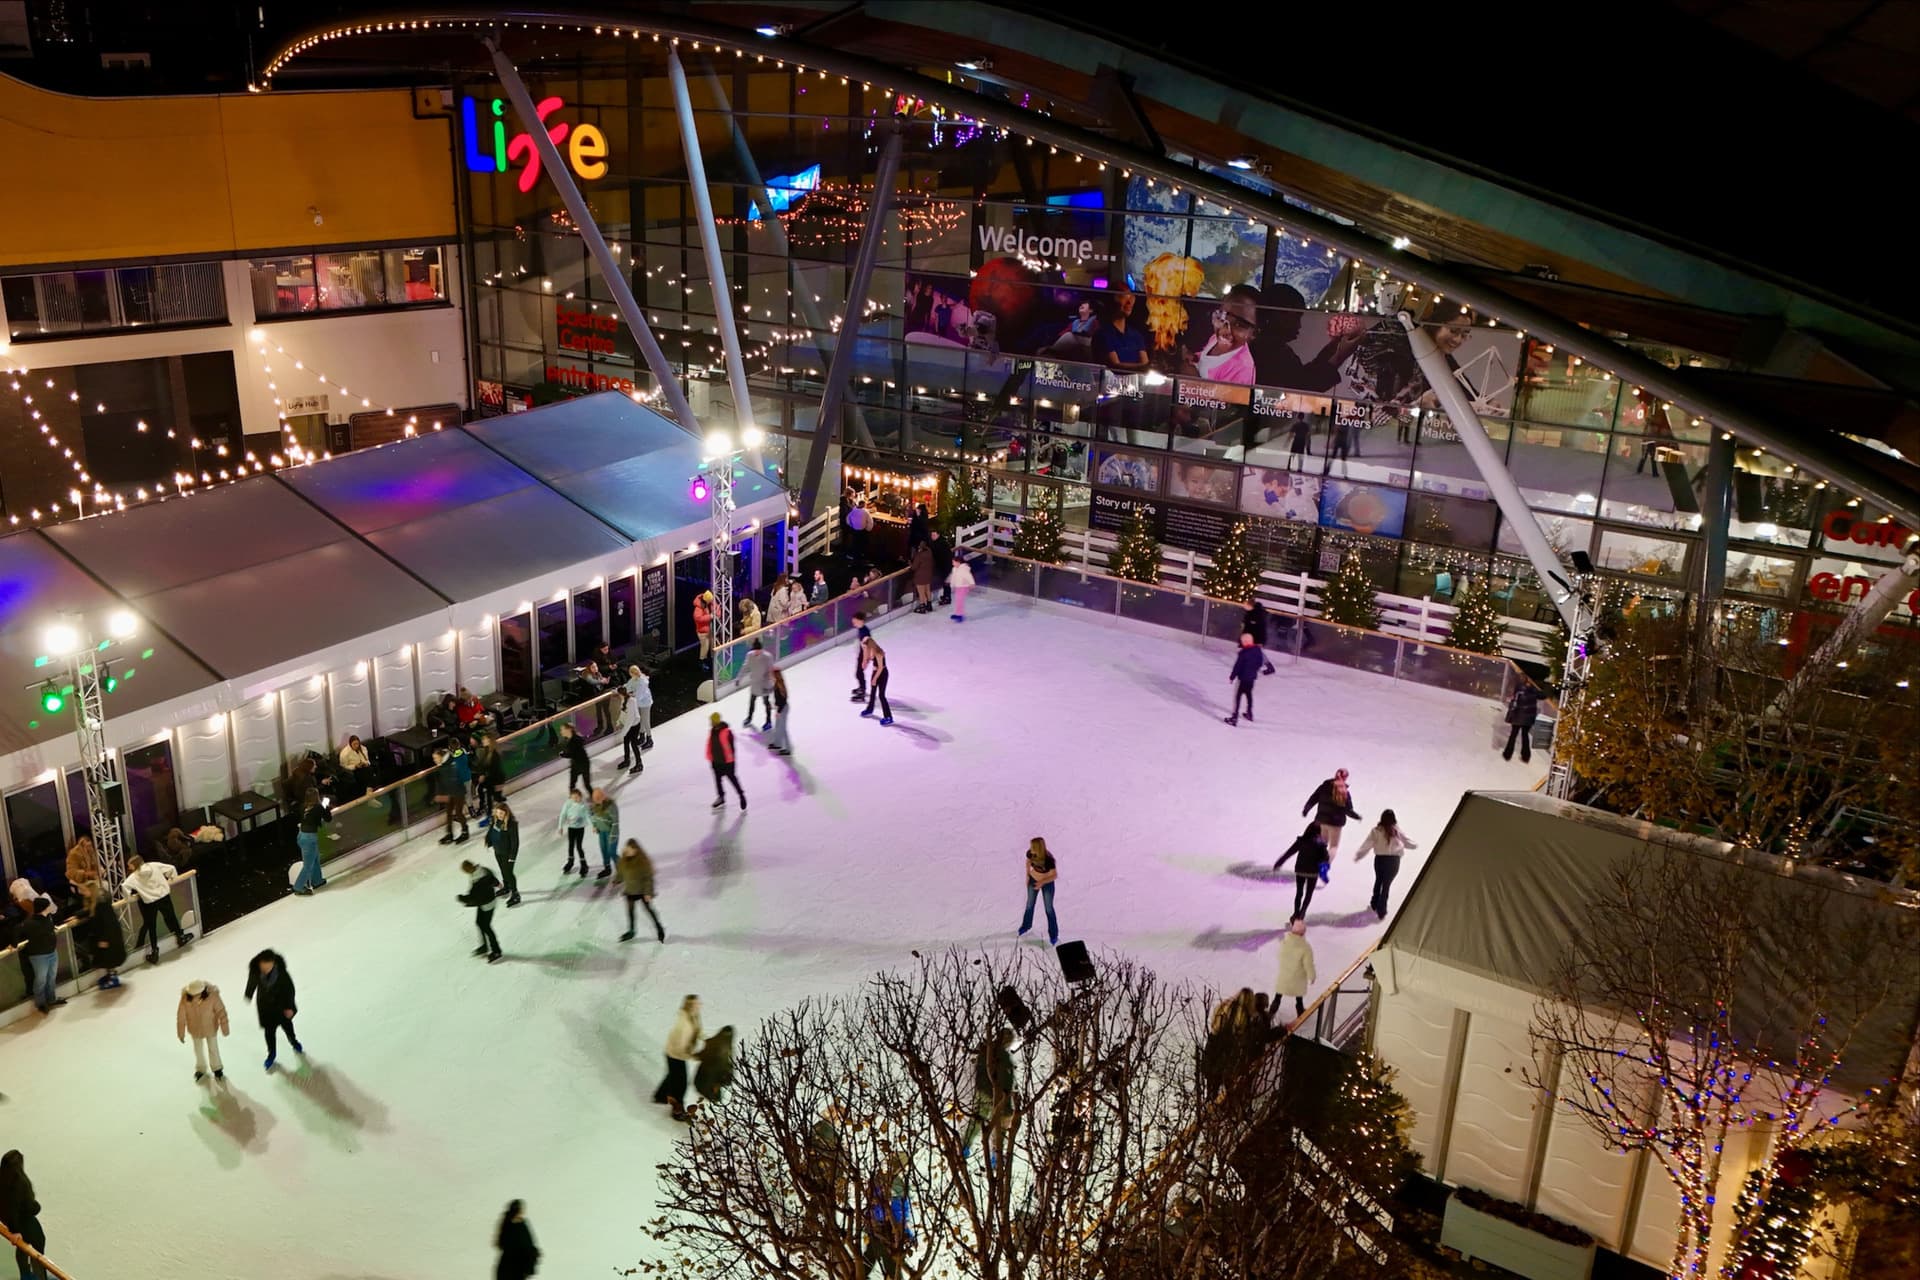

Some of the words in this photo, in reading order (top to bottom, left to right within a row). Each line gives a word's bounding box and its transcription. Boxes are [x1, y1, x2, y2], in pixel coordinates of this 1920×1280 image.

[978, 225, 1117, 261] Welcome...
[557, 304, 618, 332] Science
[561, 328, 615, 354] Centre
[1036, 377, 1092, 392] Adventurers
[1179, 384, 1216, 398] Excited
[1178, 394, 1226, 410] Explorers
[1253, 403, 1293, 419] Solvers
[1335, 414, 1372, 430] Lovers
[1096, 495, 1120, 510] Story
[1121, 501, 1131, 510] of
